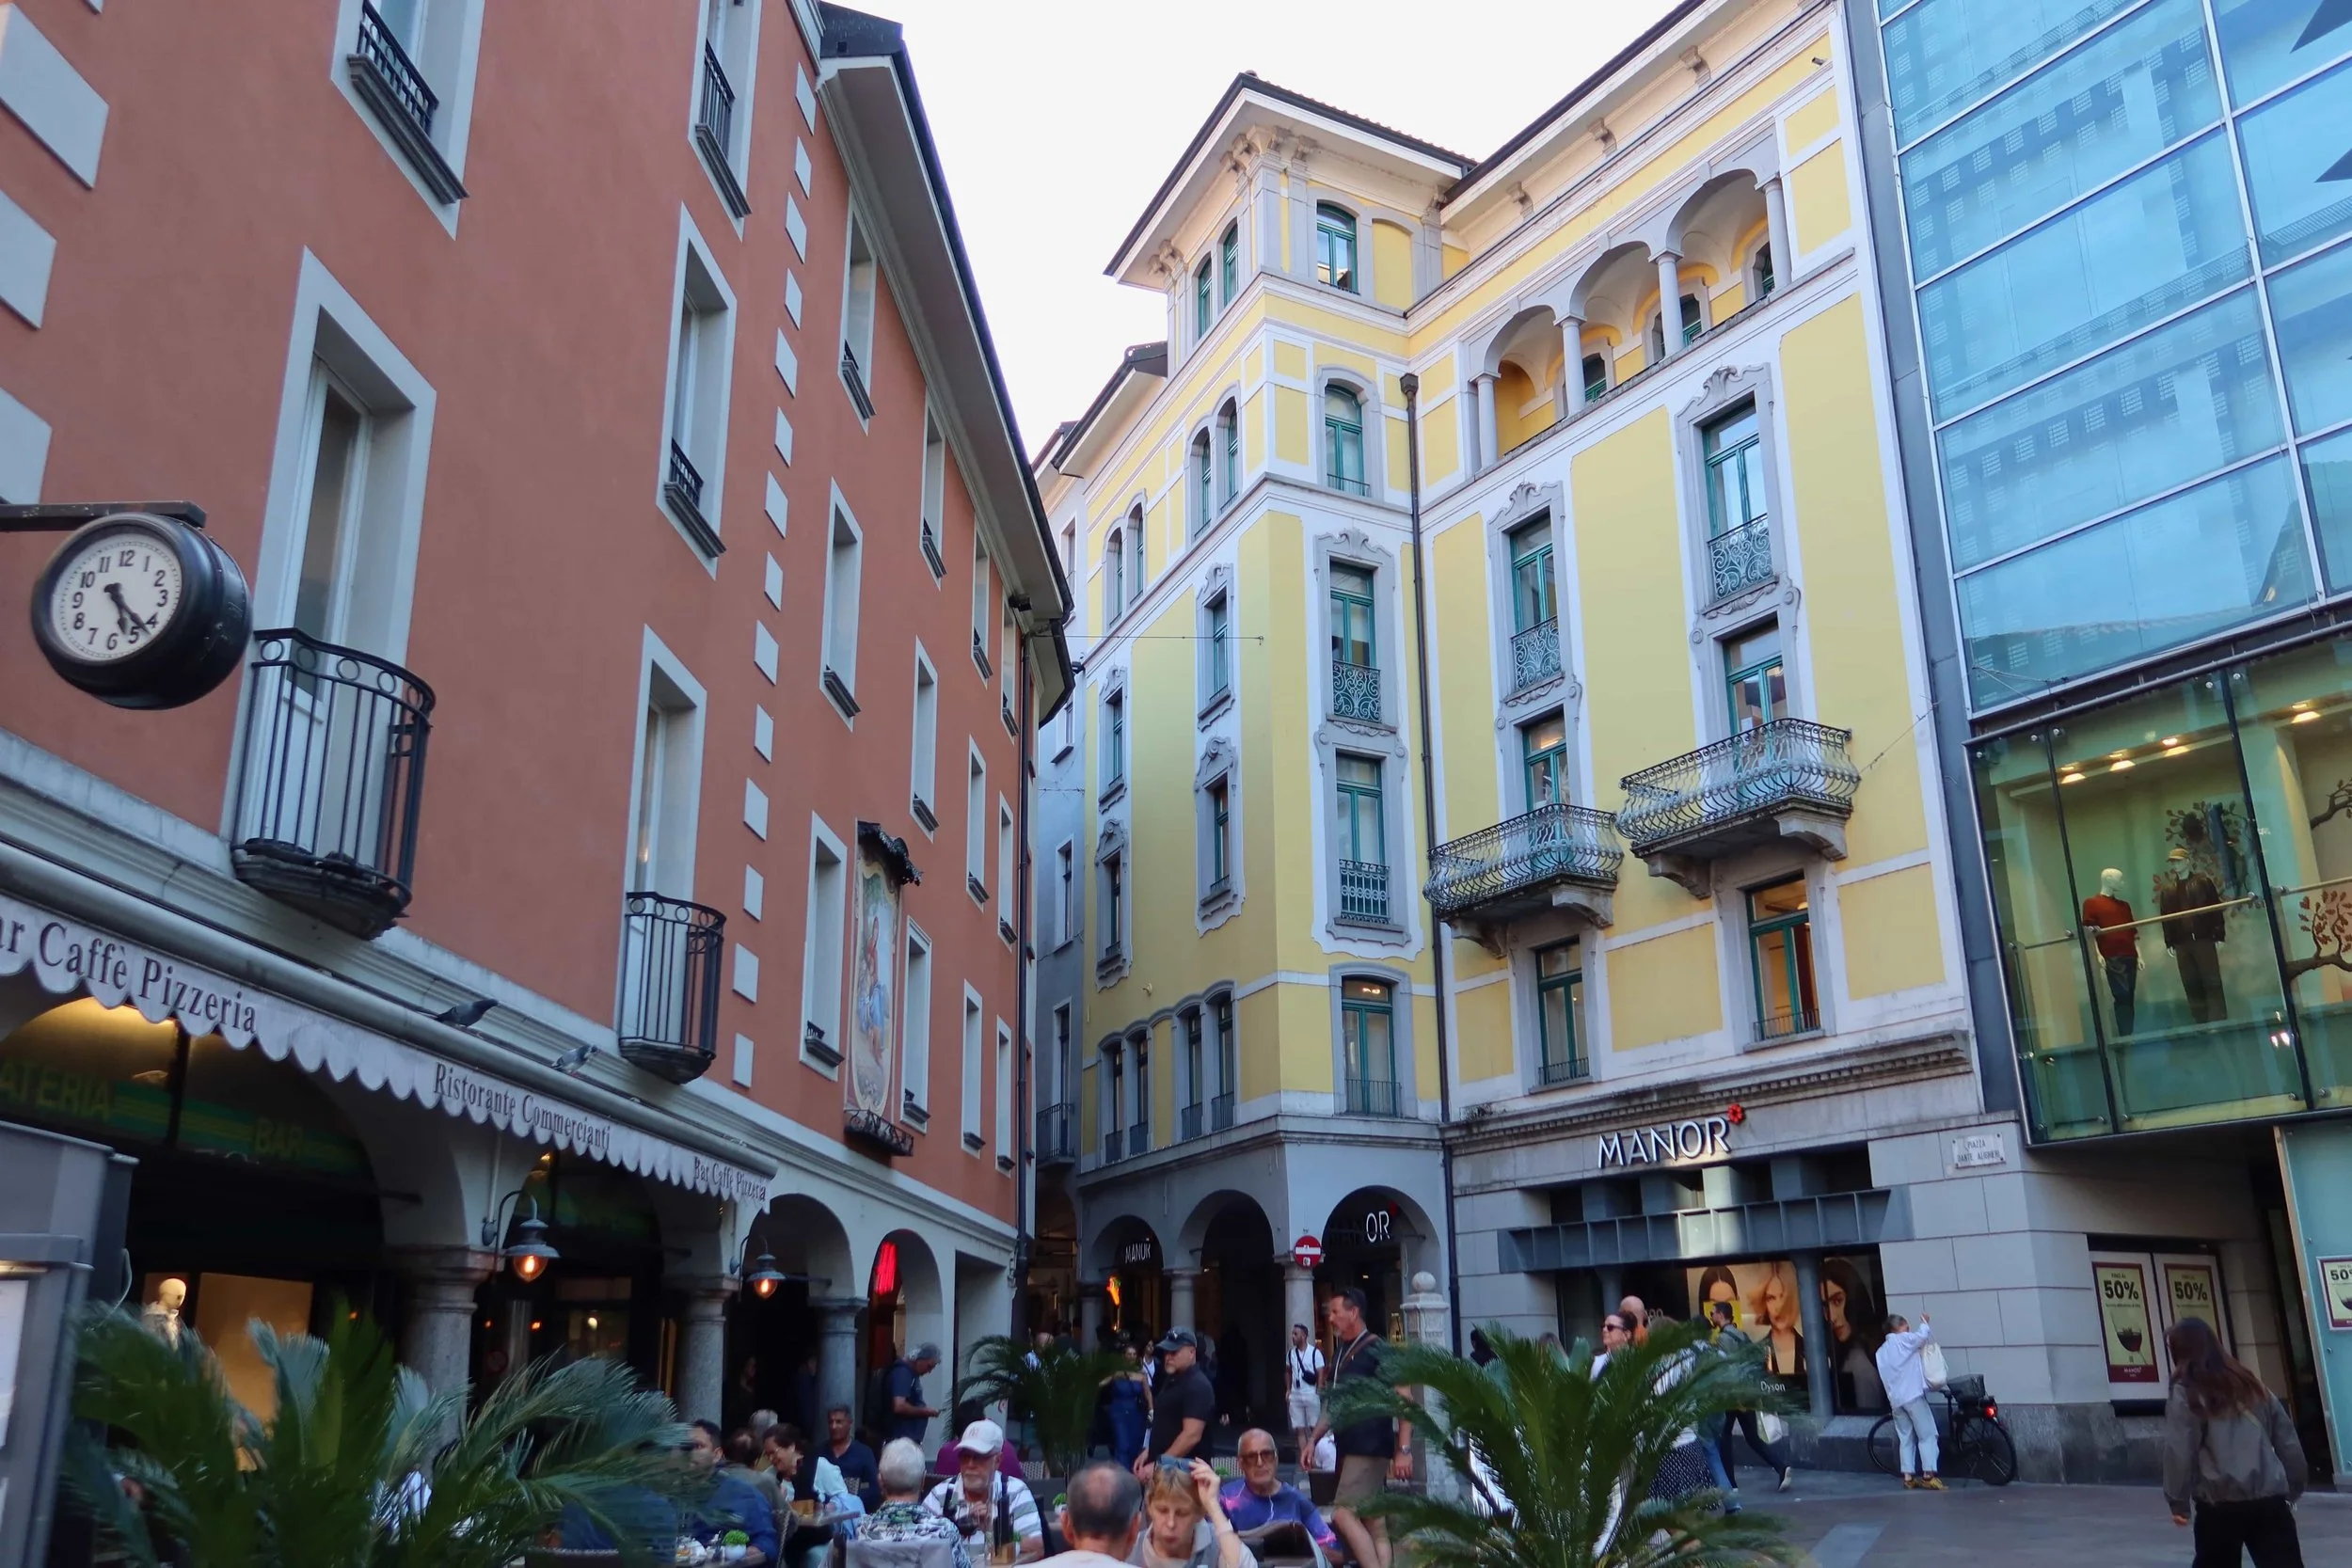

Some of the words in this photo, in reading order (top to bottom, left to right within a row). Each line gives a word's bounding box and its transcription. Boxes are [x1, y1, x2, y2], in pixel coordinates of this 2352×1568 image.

[98, 556, 111, 573] 11
[119, 549, 135, 567] 12
[143, 555, 151, 572] 1
[80, 571, 96, 589] 10
[153, 569, 167, 587] 2
[72, 592, 85, 610] 9
[156, 589, 168, 608] 3
[73, 611, 86, 630] 8
[146, 611, 158, 629] 4
[87, 627, 100, 645] 7
[106, 632, 119, 651] 6
[128, 626, 140, 644] 5
[39, 921, 128, 990] Caffè
[138, 956, 257, 1035] Pizzeria
[433, 1061, 516, 1117] Ristorante
[522, 1094, 611, 1150] Commercianti
[1597, 1117, 1732, 1169] MANOR
[694, 1156, 709, 1181] Bar
[2104, 1279, 2139, 1300] 50%
[2174, 1280, 2208, 1300] 50%
[1760, 1380, 1786, 1392] Dyson
